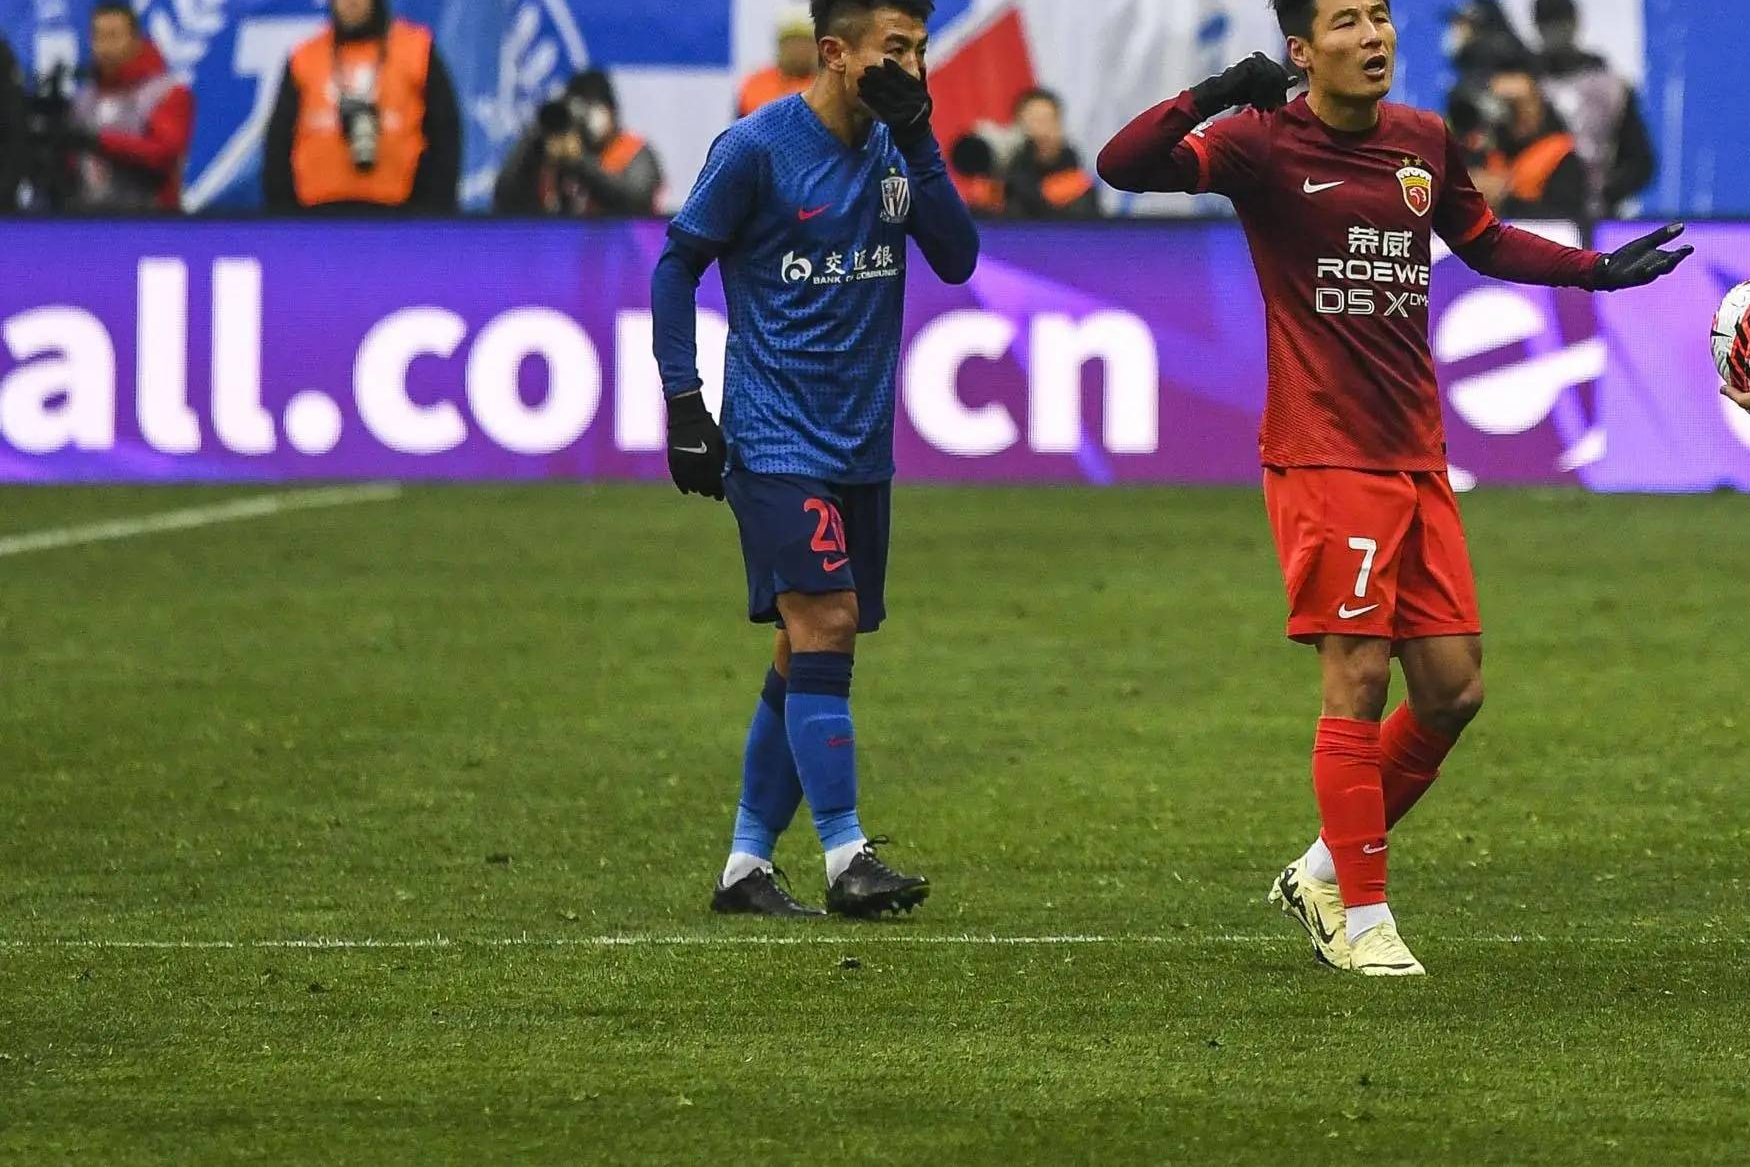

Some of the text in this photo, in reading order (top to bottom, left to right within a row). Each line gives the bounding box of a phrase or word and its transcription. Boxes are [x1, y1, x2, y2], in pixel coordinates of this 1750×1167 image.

[1348, 226, 1413, 257] 荣威
[813, 275, 842, 285] BANK
[1317, 257, 1430, 286] ROEWE
[1348, 536, 1377, 598] 7
